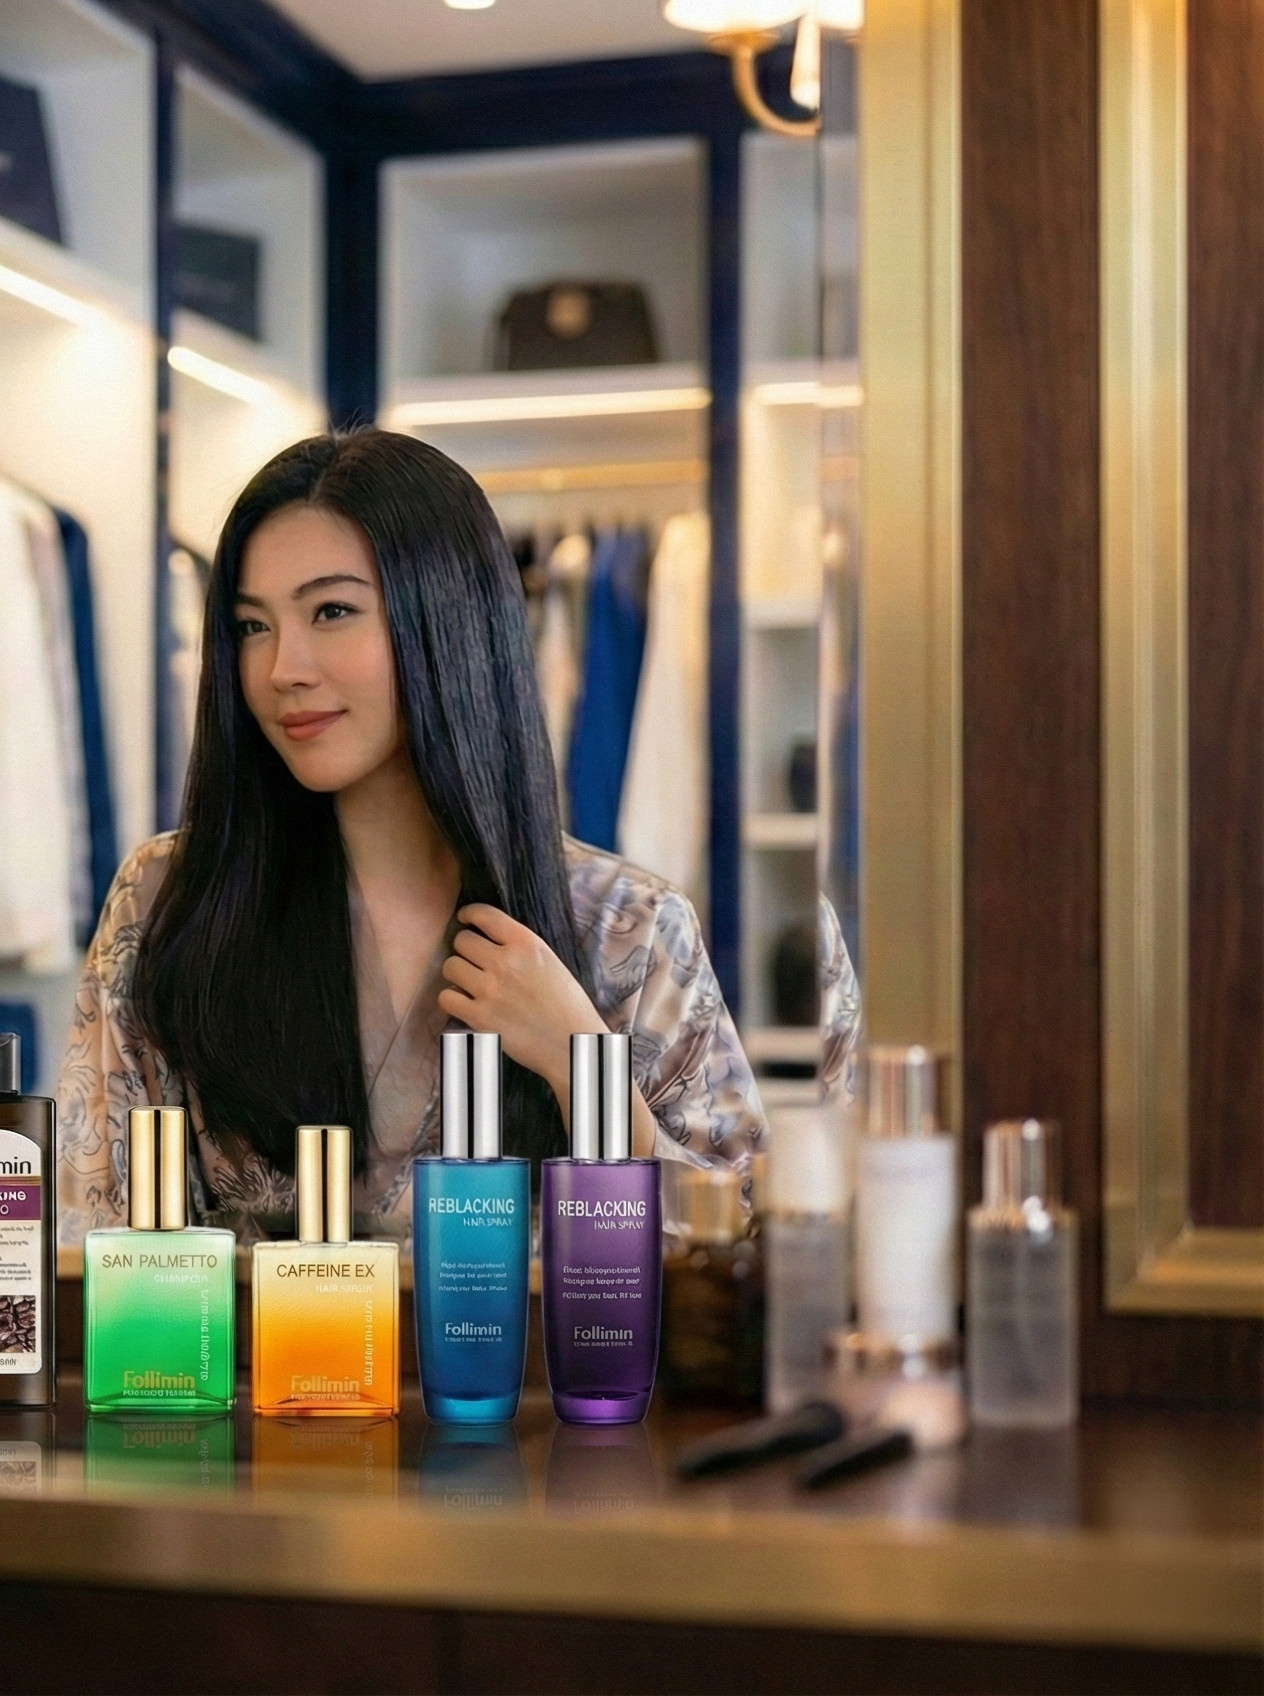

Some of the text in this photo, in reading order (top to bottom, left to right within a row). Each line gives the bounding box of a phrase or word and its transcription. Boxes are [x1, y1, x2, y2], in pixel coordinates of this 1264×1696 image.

[428, 1198, 515, 1214] REBLACKING
[558, 1200, 646, 1217] REBLACKING
[101, 1254, 218, 1268] SAN PALMETTO
[276, 1264, 375, 1278] CAFFEINE EX
[445, 1322, 502, 1336] Follimin
[574, 1326, 633, 1340] Follimin
[123, 1370, 196, 1389] Follimin
[291, 1375, 360, 1393] Follimin
